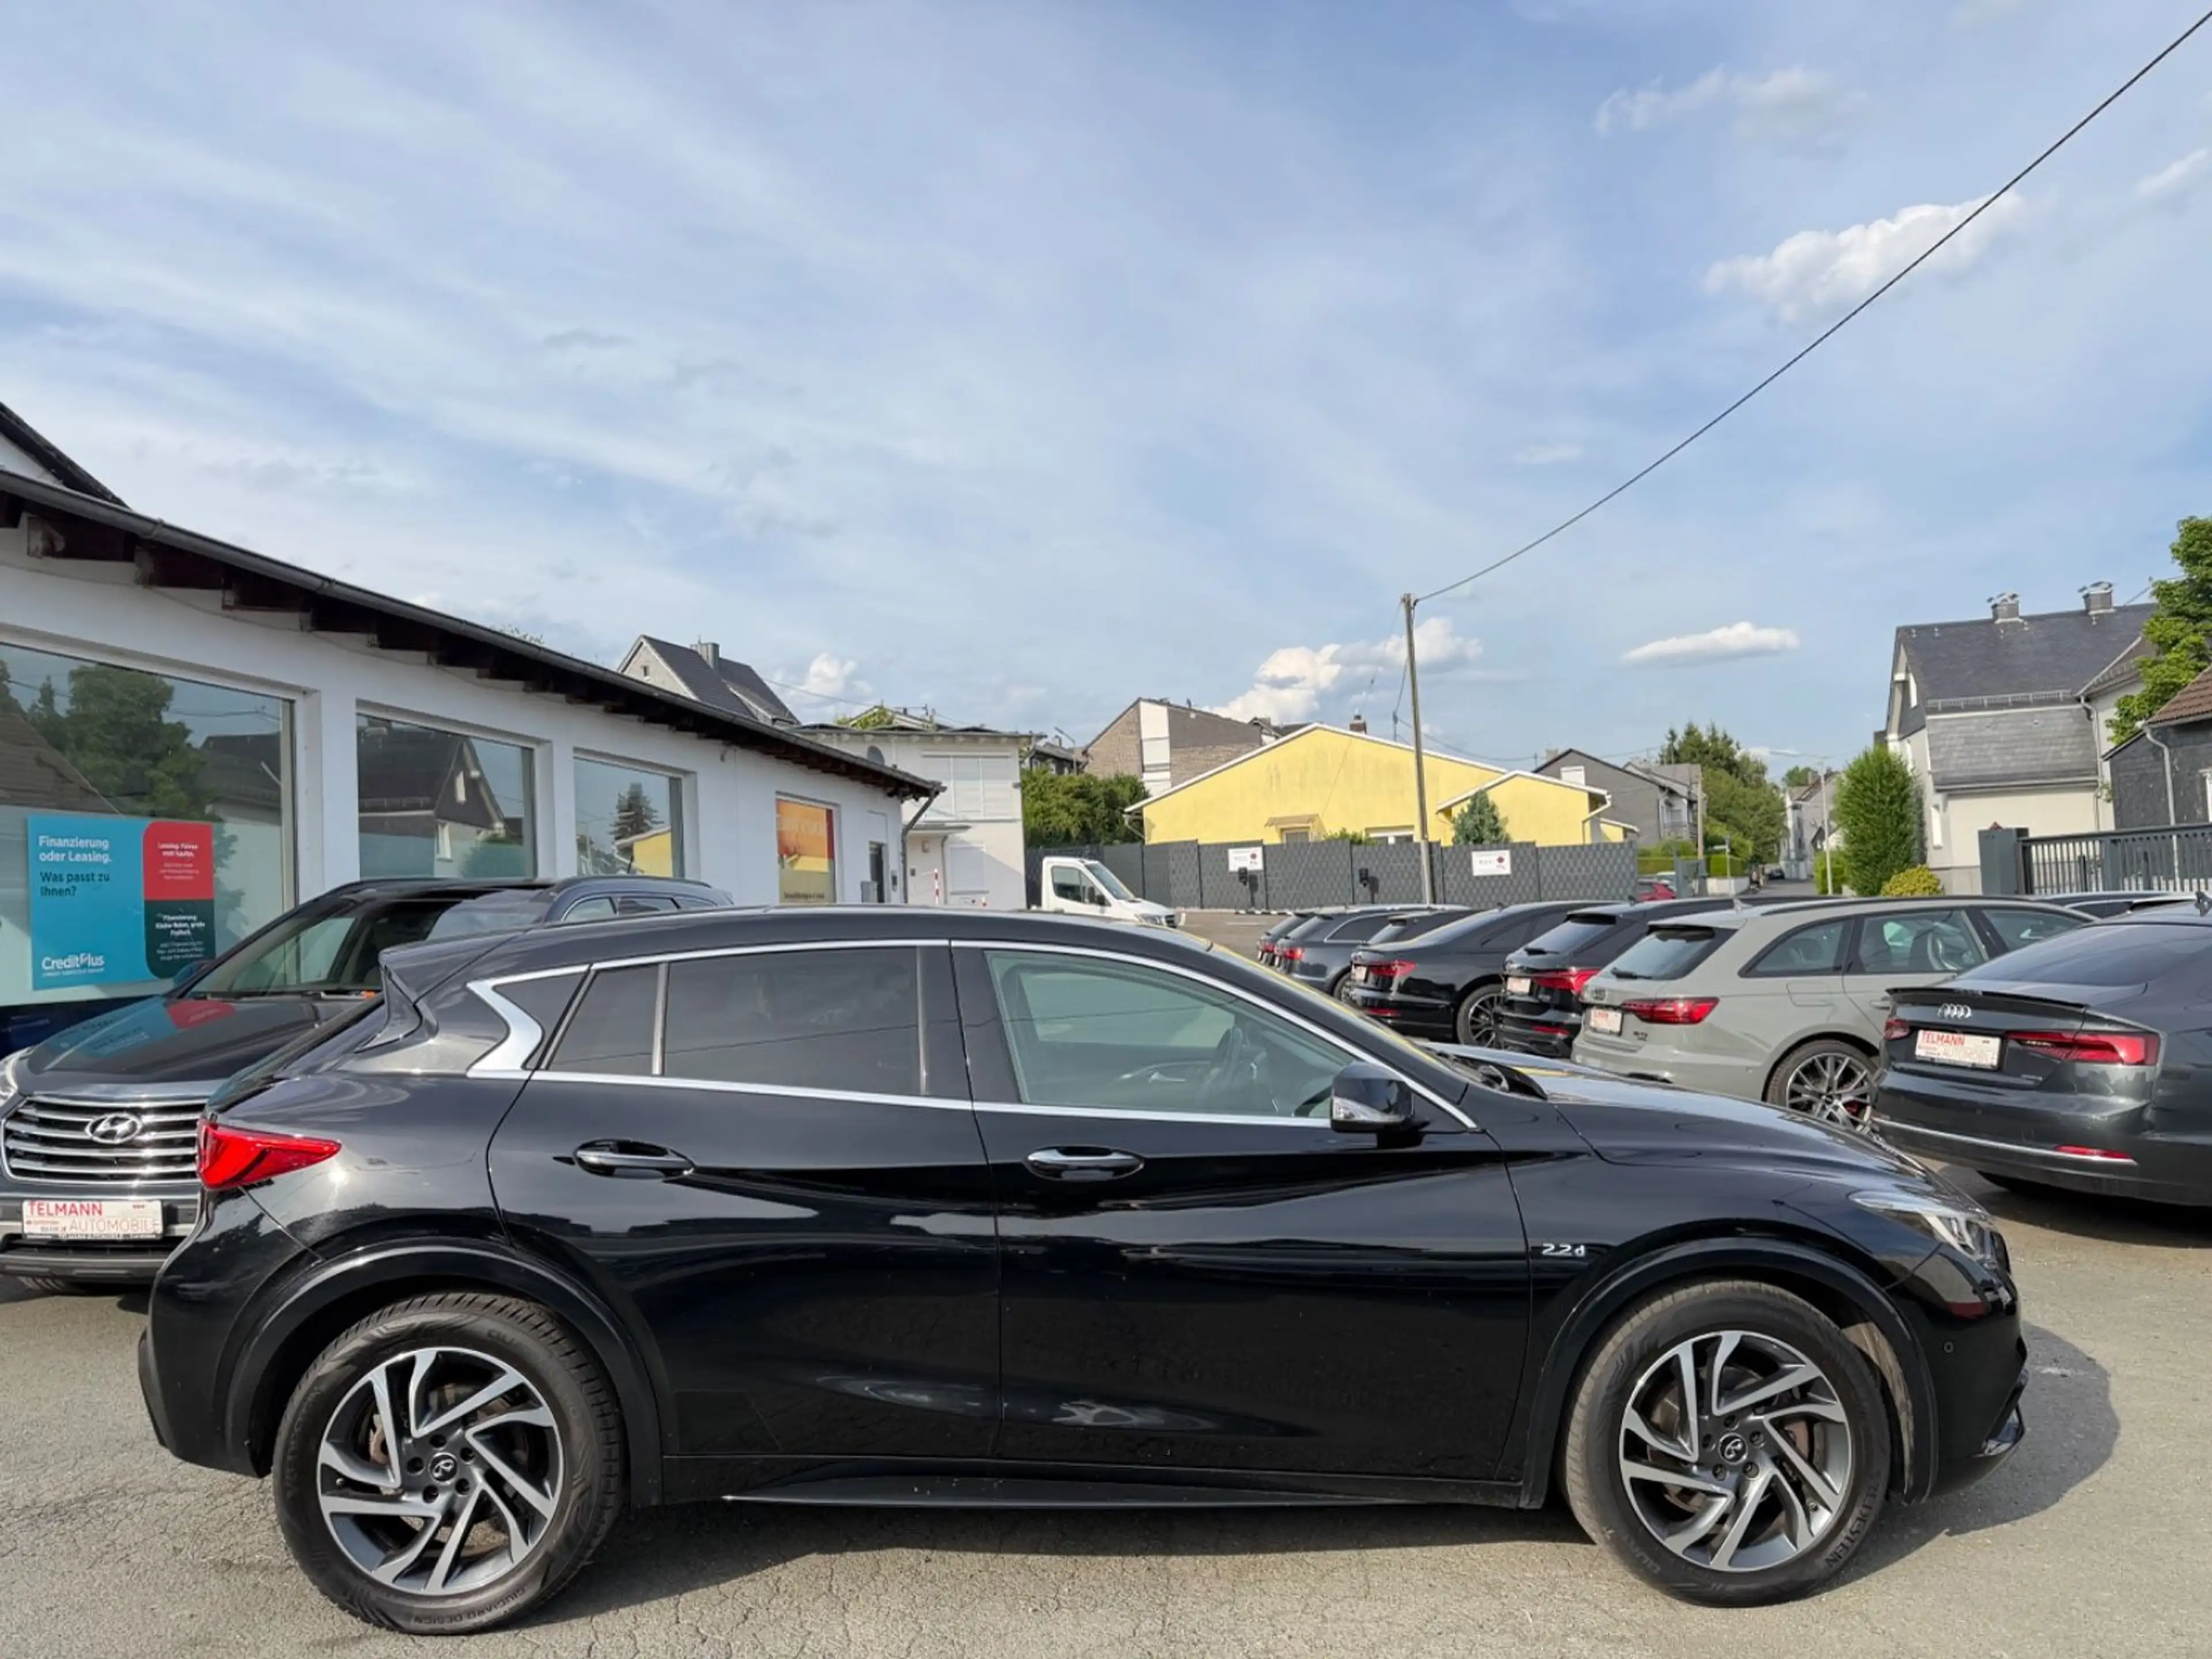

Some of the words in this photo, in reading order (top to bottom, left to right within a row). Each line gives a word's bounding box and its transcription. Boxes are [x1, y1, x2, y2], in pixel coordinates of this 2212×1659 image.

[38, 835, 109, 851] Finanzierung
[39, 850, 66, 862] oder
[68, 850, 112, 864] Leasing.
[40, 870, 63, 882] Was
[66, 872, 94, 885] passt
[97, 873, 109, 882] zu
[40, 885, 77, 897] Ihnen?
[41, 953, 105, 970] CreditPlus
[1923, 1030, 1965, 1046] TELMANN
[29, 1200, 103, 1217] TELMANN
[414, 1613, 463, 1624] DESIGN
